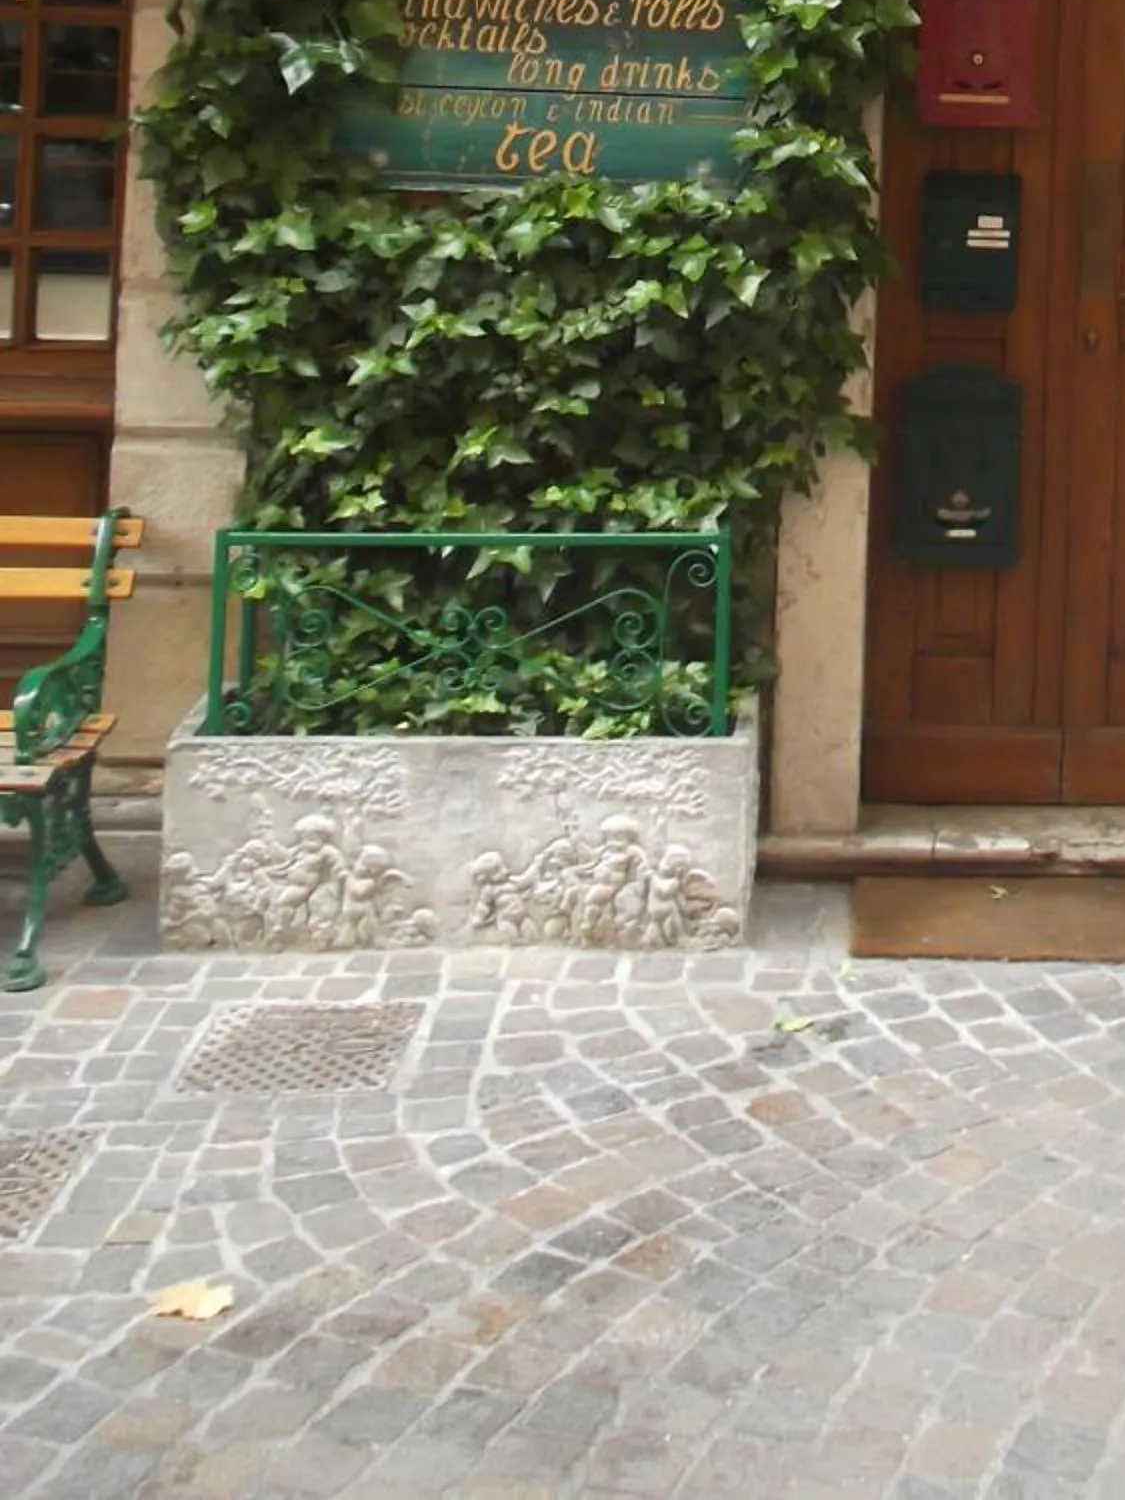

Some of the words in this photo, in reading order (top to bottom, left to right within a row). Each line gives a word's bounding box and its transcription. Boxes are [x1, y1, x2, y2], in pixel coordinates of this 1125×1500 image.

[401, 16, 547, 54] ocktails
[507, 51, 586, 99] long
[601, 52, 721, 92] drinks
[575, 95, 676, 125] indian
[495, 120, 600, 176] tea
